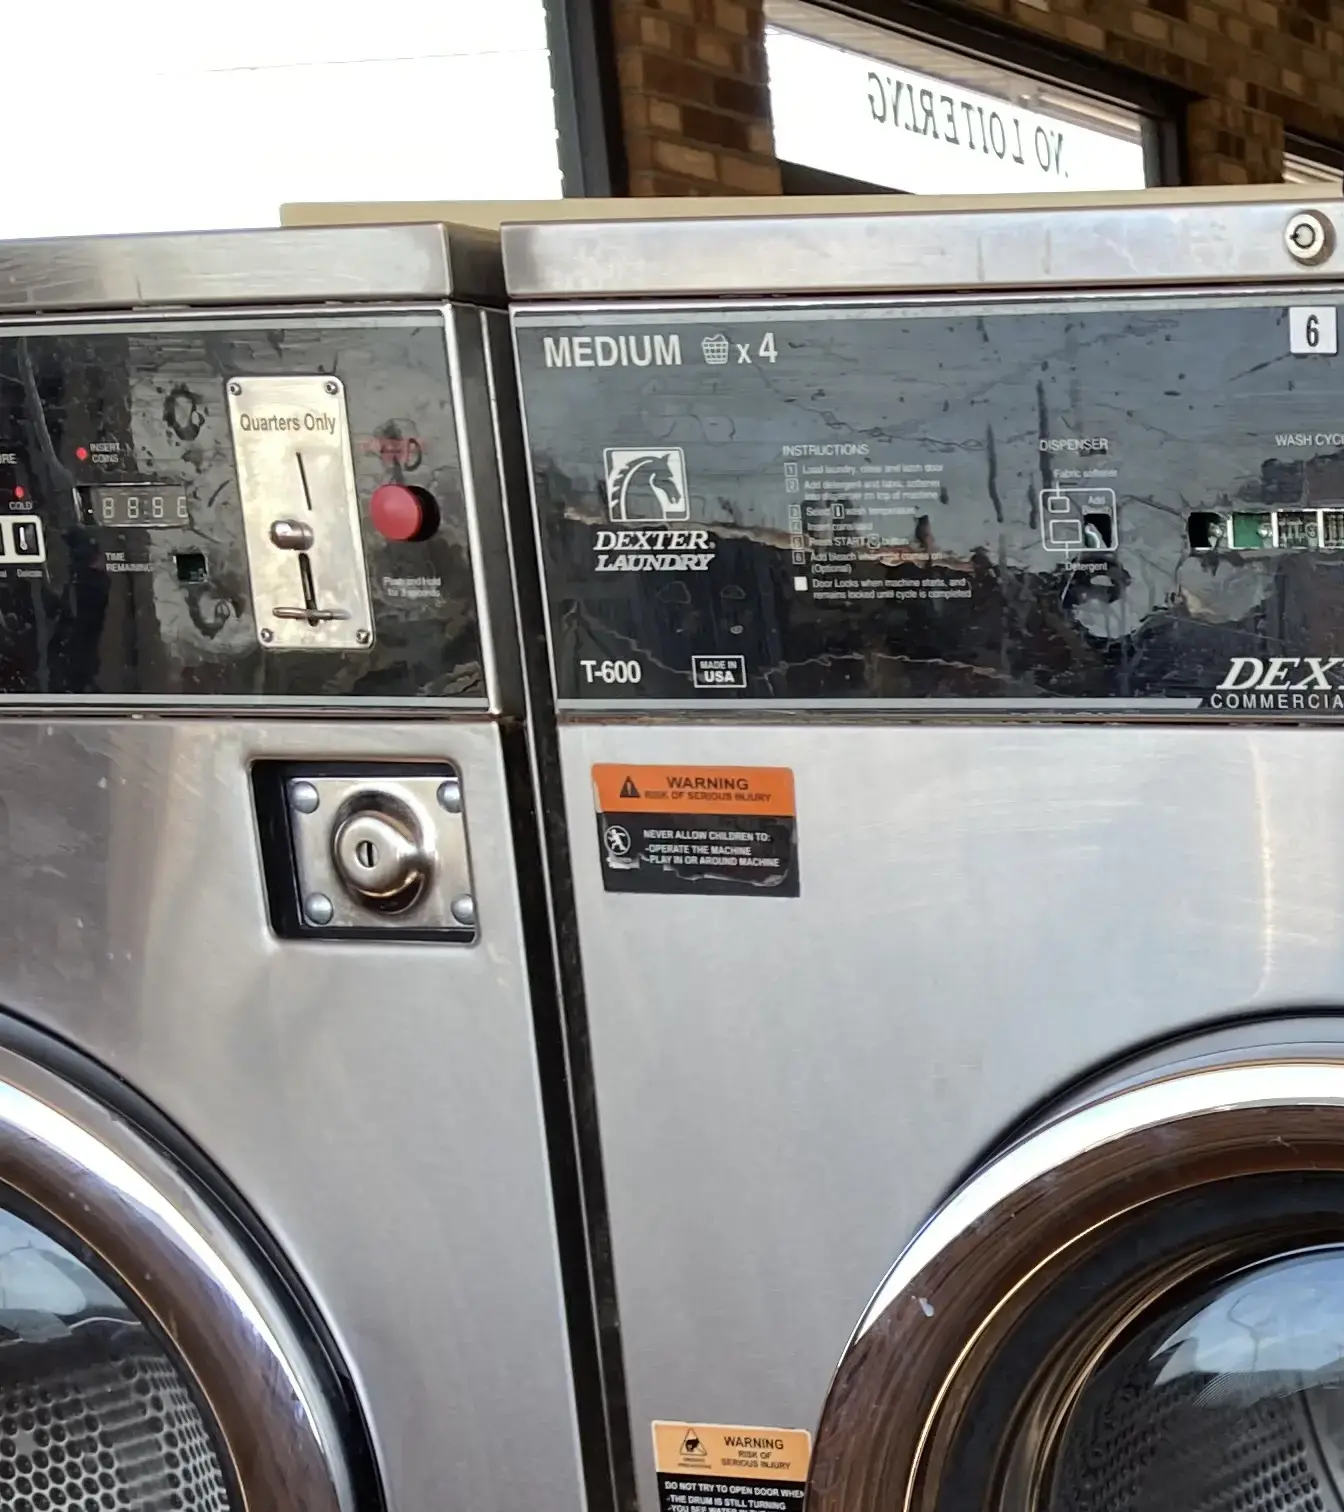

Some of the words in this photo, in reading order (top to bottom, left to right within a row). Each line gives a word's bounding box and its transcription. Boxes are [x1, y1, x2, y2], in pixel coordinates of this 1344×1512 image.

[1307, 314, 1319, 347] 6
[543, 334, 682, 367] MEDIUM
[759, 332, 778, 362] 4
[240, 413, 300, 432] Quarters
[304, 413, 336, 435] Only
[1039, 438, 1109, 452] DISPENSER
[1275, 434, 1312, 446] WASH
[90, 443, 120, 451] INSERT
[783, 444, 869, 456] INSTRUCTIONS
[9, 501, 33, 510] COLD
[593, 530, 709, 551] DEXTER
[106, 553, 125, 562] TIME
[595, 553, 715, 571] LAUNDRY
[1065, 561, 1108, 573] Detergent
[580, 660, 641, 683] T-600
[700, 660, 726, 670] MADE
[728, 660, 737, 669] IN
[704, 671, 735, 683] USA
[666, 776, 749, 790] WARNING
[724, 1436, 783, 1449] WARNING
